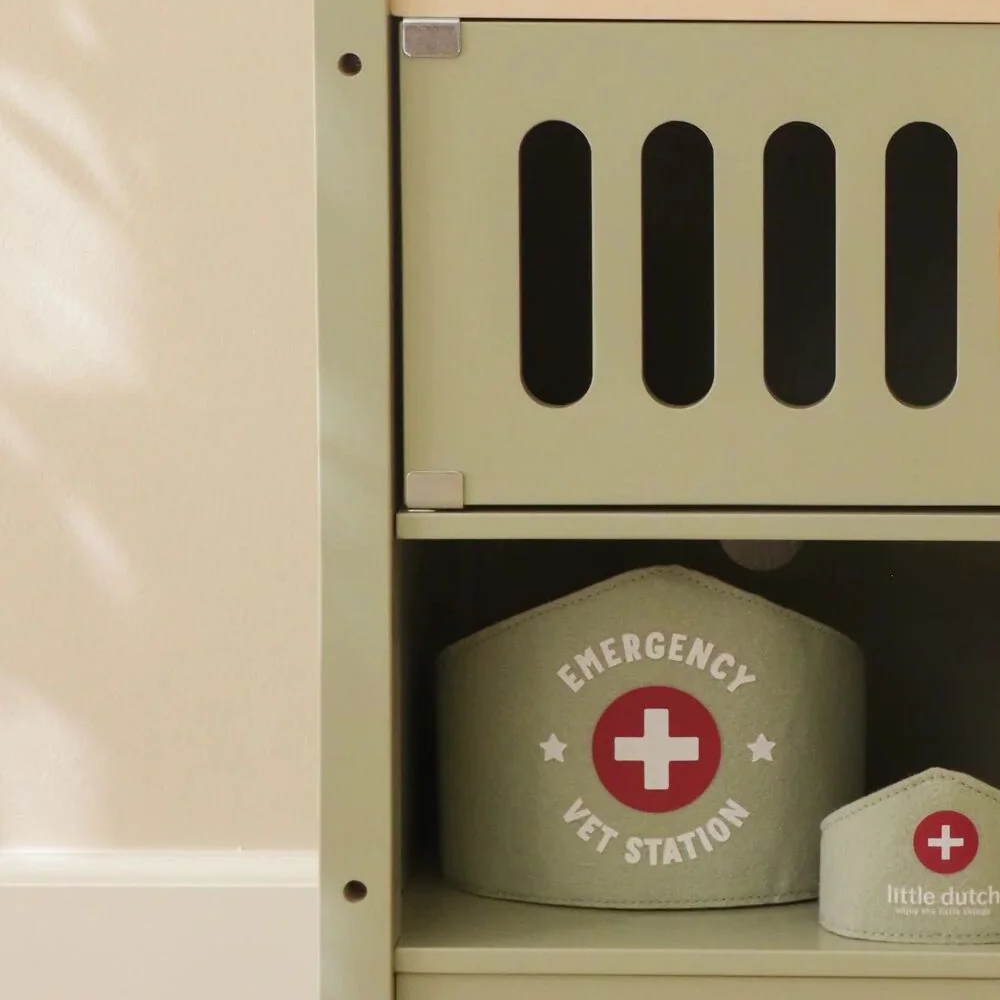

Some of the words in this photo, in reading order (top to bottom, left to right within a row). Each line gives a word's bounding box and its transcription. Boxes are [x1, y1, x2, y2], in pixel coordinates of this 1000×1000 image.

[556, 631, 756, 693] EMERGENCY
[563, 797, 619, 853] VET
[624, 798, 750, 866] STATION
[887, 884, 936, 905] little
[941, 885, 1000, 906] dutch
